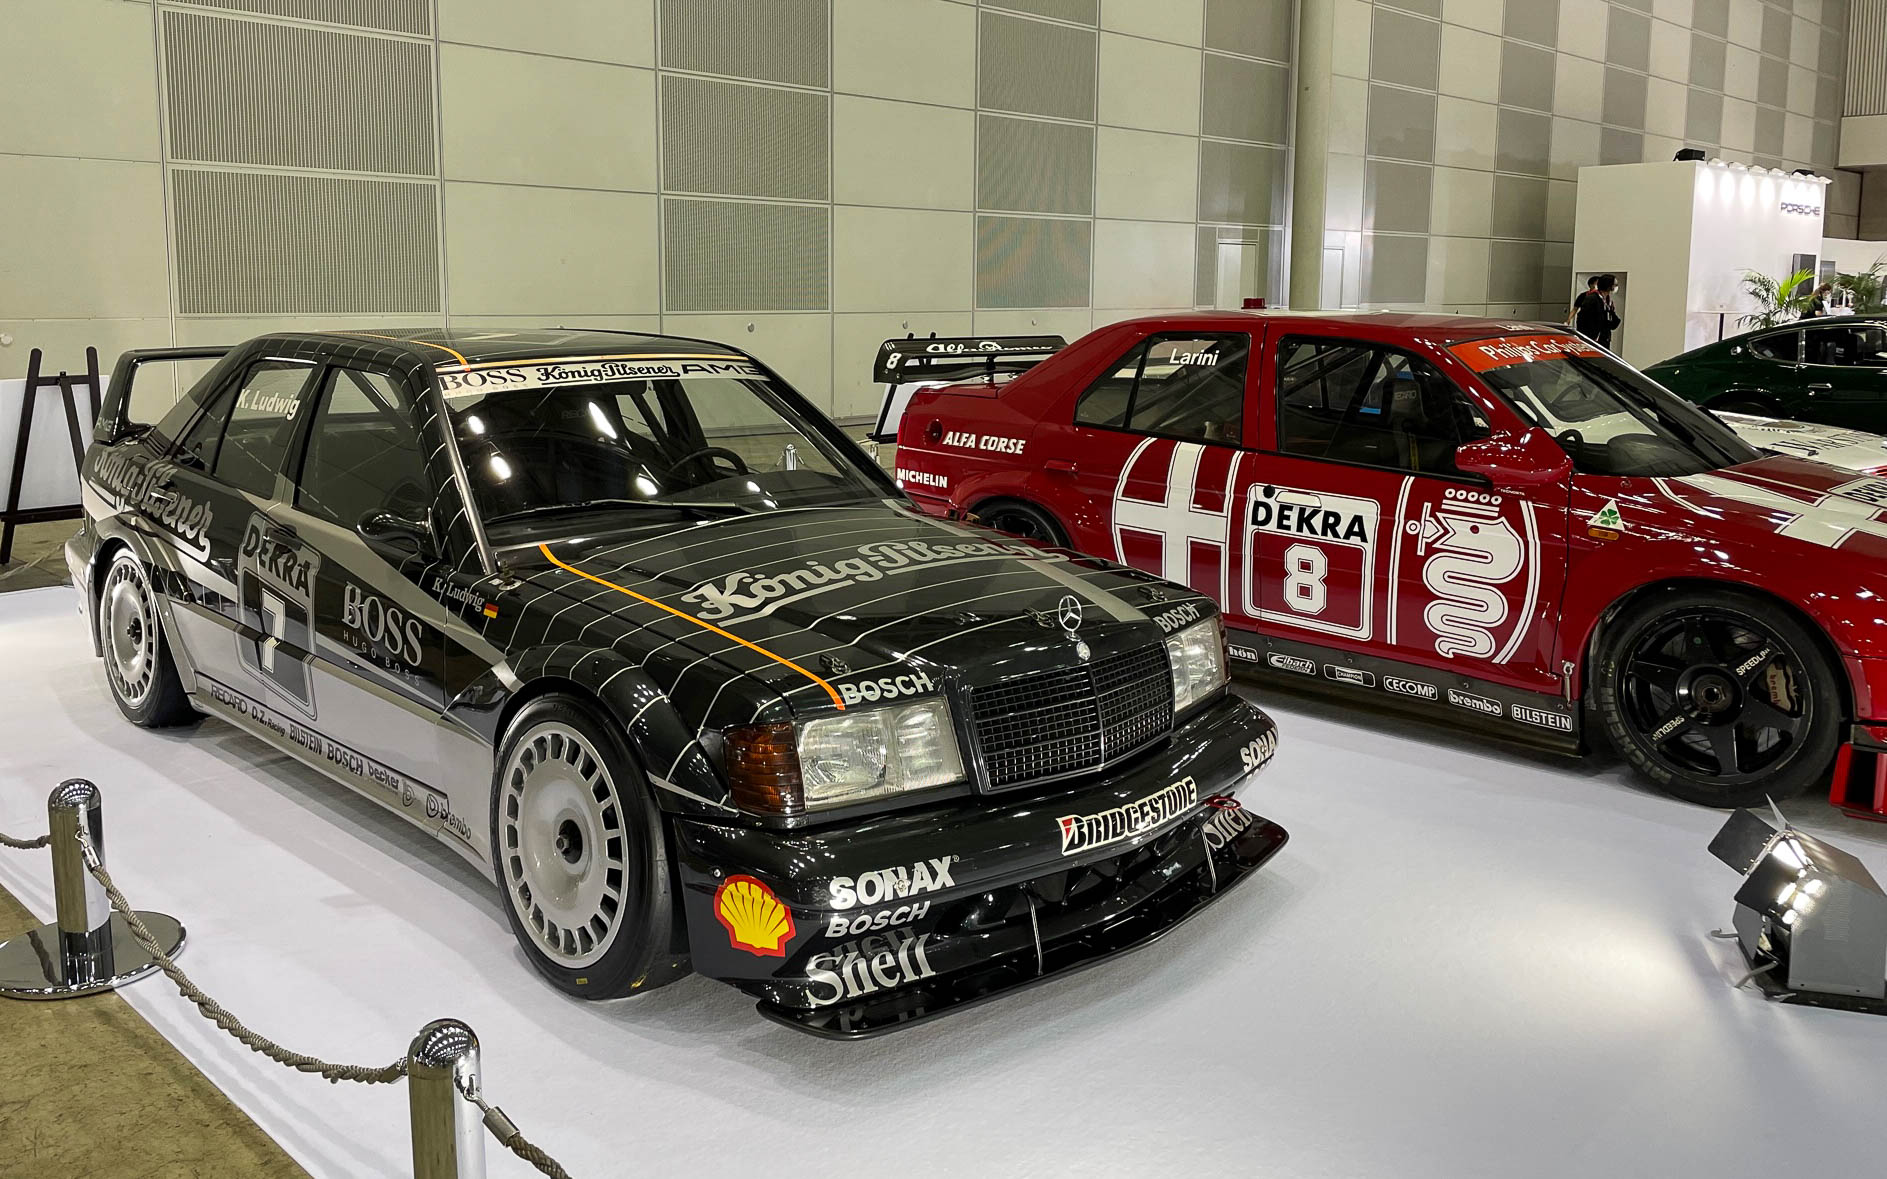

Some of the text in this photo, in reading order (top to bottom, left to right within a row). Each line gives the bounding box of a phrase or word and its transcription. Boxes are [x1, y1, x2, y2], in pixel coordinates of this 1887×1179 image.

[1780, 201, 1821, 216] PORSCHE
[885, 352, 902, 370] 8
[1169, 348, 1219, 367] Larini
[1530, 340, 1561, 354] Car
[438, 368, 527, 390] BOSS
[236, 389, 301, 420] K. Ludwig
[943, 431, 1026, 455] ALFA CORSE
[897, 468, 948, 489] MICHELIN
[1250, 499, 1369, 544] DEKRA
[243, 525, 311, 598] DEKRA
[1283, 543, 1328, 615] 8
[446, 581, 486, 612] Ludwig
[261, 588, 286, 674] 7
[341, 581, 423, 667] BOSS
[1155, 602, 1201, 634] BOSCH
[343, 629, 420, 686] HUGO BOSS
[838, 671, 934, 706] BOSCH
[1385, 677, 1436, 699] CECOMP
[1450, 690, 1501, 715] brembo
[1513, 706, 1572, 730] BILSTEIN
[211, 684, 248, 715] RECARO
[267, 718, 286, 737] Racing
[289, 723, 323, 755] BILSTEIN
[327, 743, 363, 776] BOSCH
[367, 761, 399, 789] becker
[1065, 778, 1197, 851] BRIDGESTONE
[825, 900, 931, 938] BOSCH
[804, 931, 937, 1006] Shell
